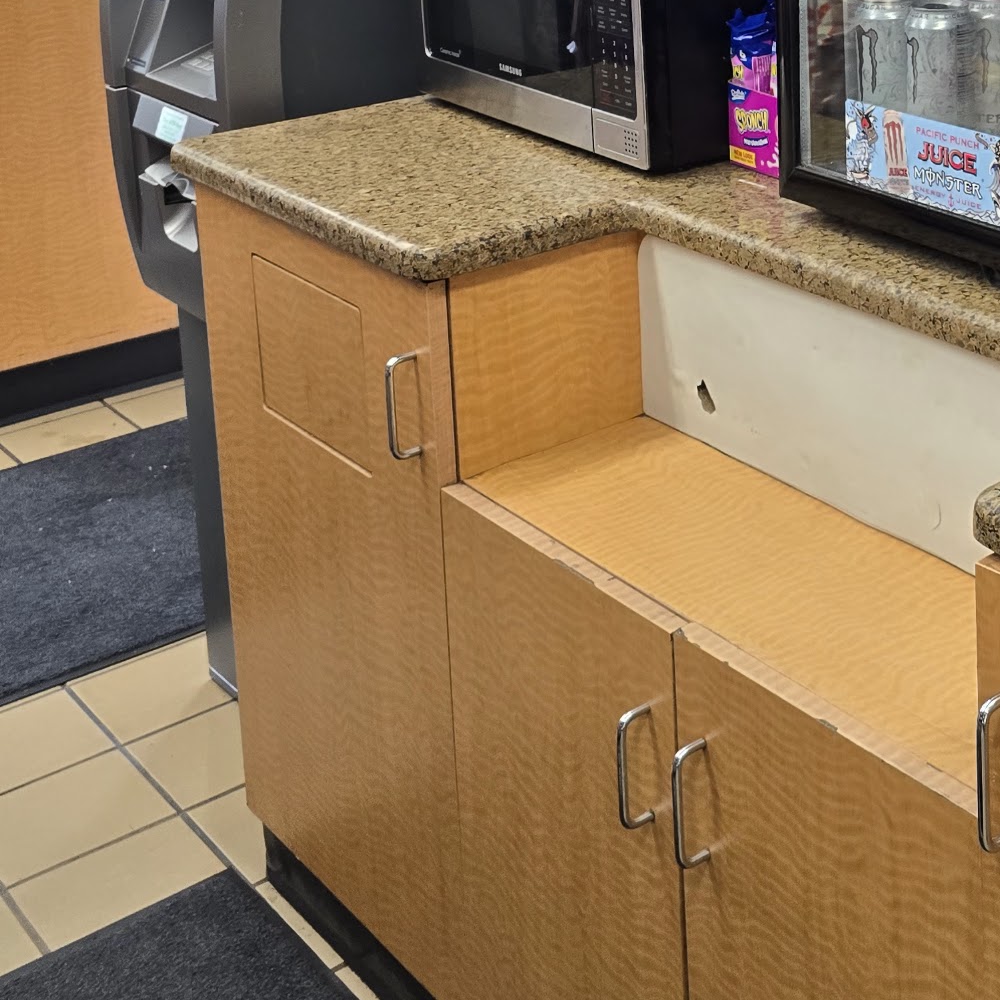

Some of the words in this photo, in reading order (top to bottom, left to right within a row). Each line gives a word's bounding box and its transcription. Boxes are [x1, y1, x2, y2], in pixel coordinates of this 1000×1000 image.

[499, 62, 523, 77] SAMSUNG
[735, 107, 768, 133] SPONCH
[916, 126, 947, 143] PACIFIC
[950, 136, 980, 150] PUNCH
[917, 140, 978, 177] JUICE
[913, 165, 984, 201] MONSTER
[914, 186, 946, 199] ENERGY
[956, 198, 982, 210] JUICE
